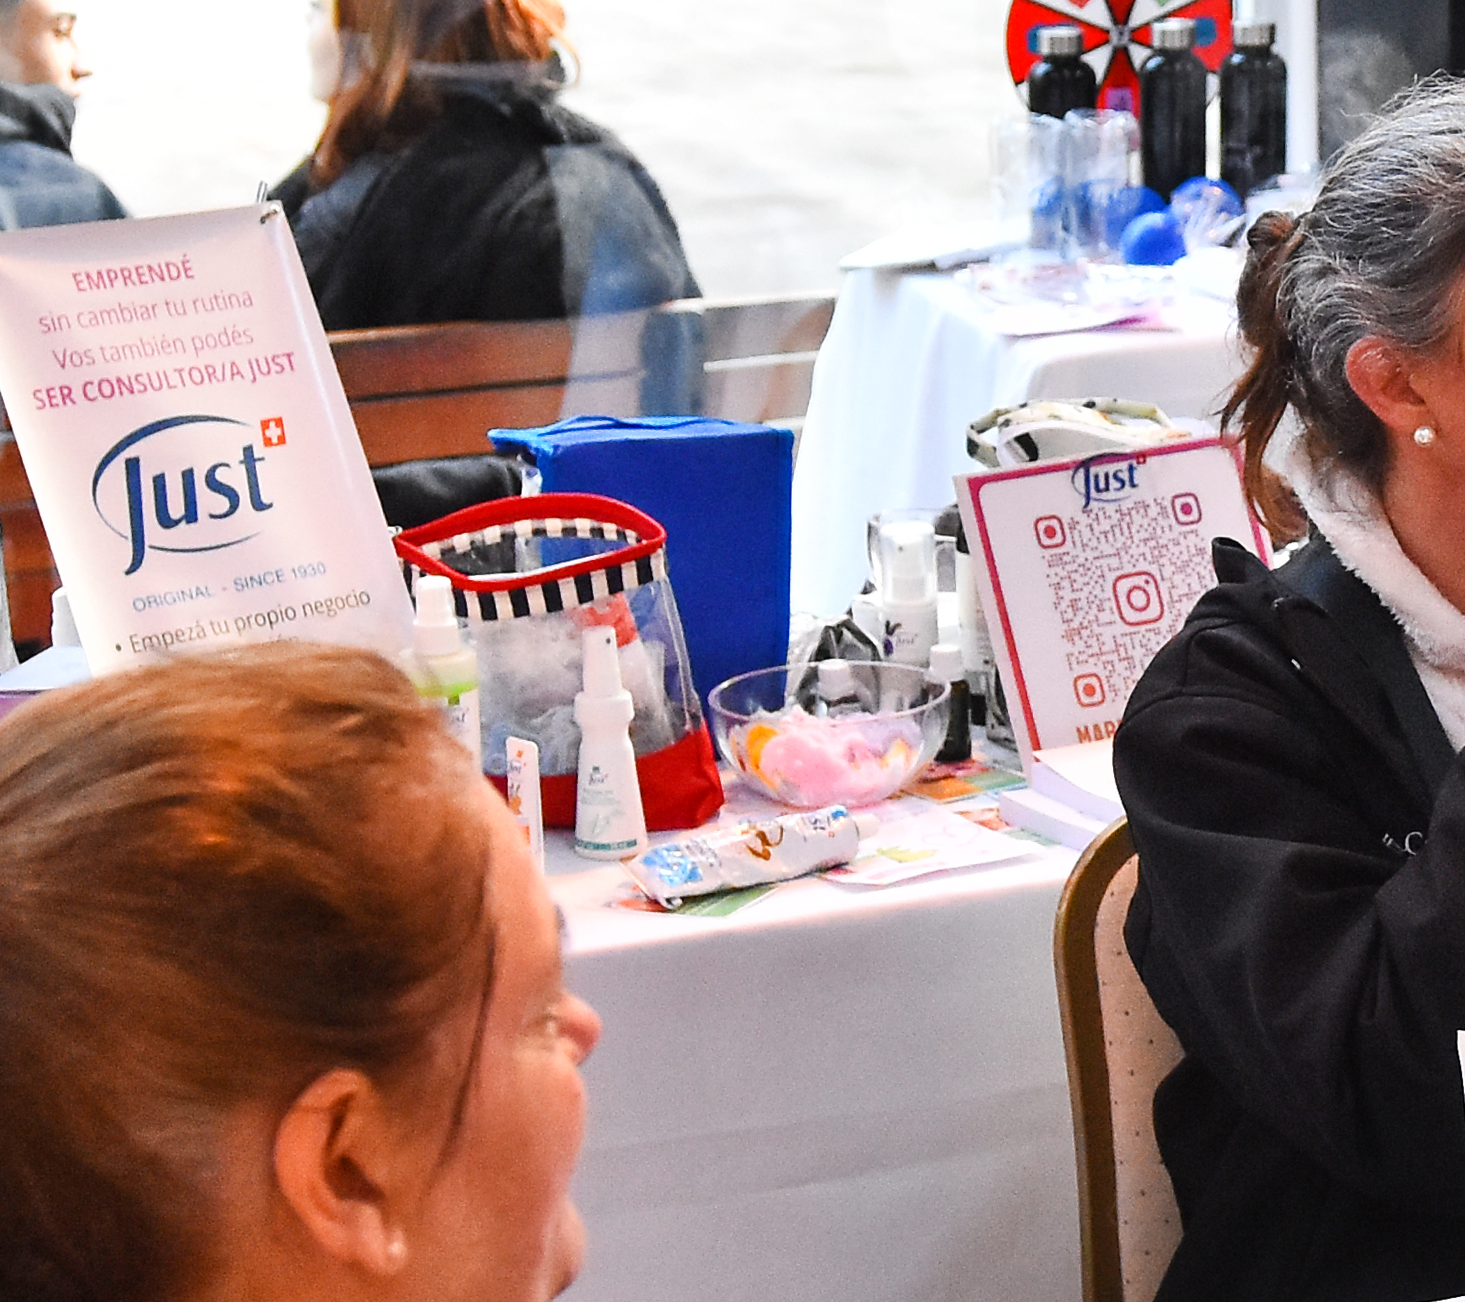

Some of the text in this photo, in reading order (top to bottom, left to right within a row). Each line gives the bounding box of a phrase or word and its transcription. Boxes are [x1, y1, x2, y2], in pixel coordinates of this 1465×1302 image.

[71, 254, 196, 292] EMPRENDÉ
[38, 288, 254, 336] sin cambiar tu rutina
[52, 325, 255, 371] Vos también podés
[32, 351, 297, 411] SER CONSULTOR/A JUST
[123, 443, 274, 577] Just
[1081, 461, 1140, 509] Just
[131, 585, 216, 613] ORIGINAL
[233, 569, 288, 593] SINCE
[291, 561, 327, 582] 1930
[129, 589, 372, 654] Empezá tu propio negocio
